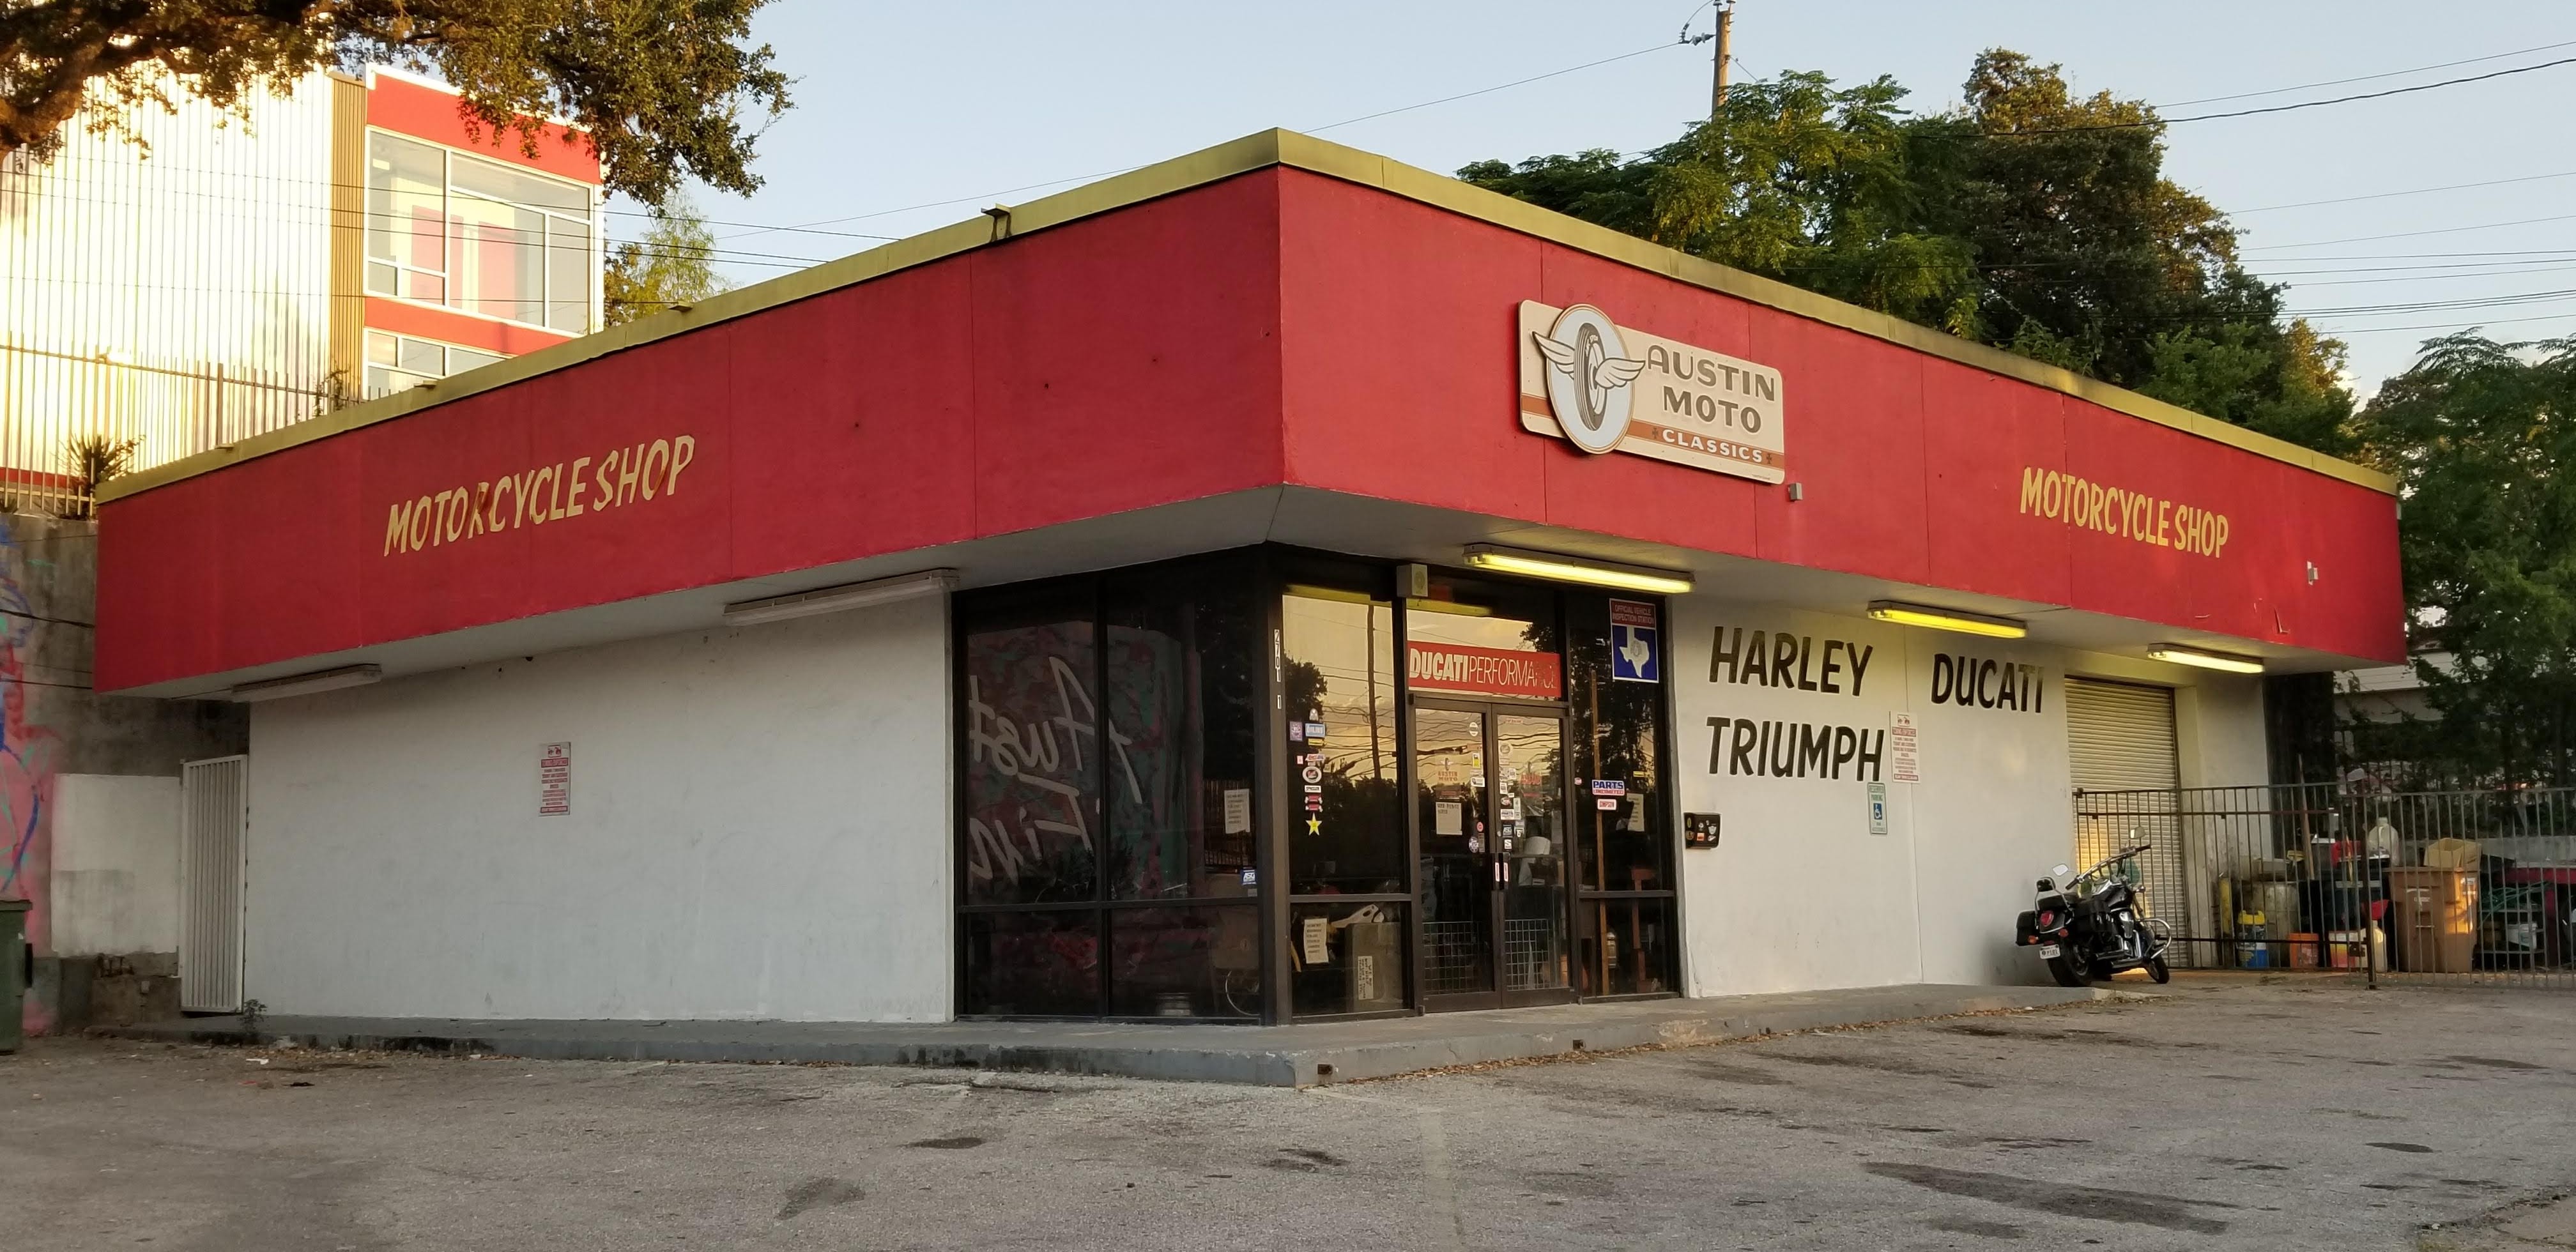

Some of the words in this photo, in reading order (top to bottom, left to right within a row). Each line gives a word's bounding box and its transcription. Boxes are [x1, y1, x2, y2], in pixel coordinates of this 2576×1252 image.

[1646, 344, 1775, 402] AUSTIN
[1663, 386, 1762, 434] MOTO
[1662, 429, 1763, 463] CLASSICS
[383, 456, 592, 556] MOTORCYCLE
[593, 434, 696, 512] SHOP
[2020, 466, 2171, 547] MOTORCYCLE
[2174, 504, 2229, 558] SHOP
[1612, 611, 1637, 622] INSPECTION
[1637, 615, 1655, 624] STATION
[1614, 604, 1634, 614] OFFICIAL
[1634, 607, 1652, 616] VEHICLE
[1408, 647, 1469, 683] DUCATI
[1468, 655, 1558, 689] PERFORMACE
[1708, 625, 1873, 697] HARLEY
[1930, 652, 2046, 714] DUCATI
[1705, 715, 1885, 782] TRIUMPH
[1593, 781, 1624, 789] PARTS
